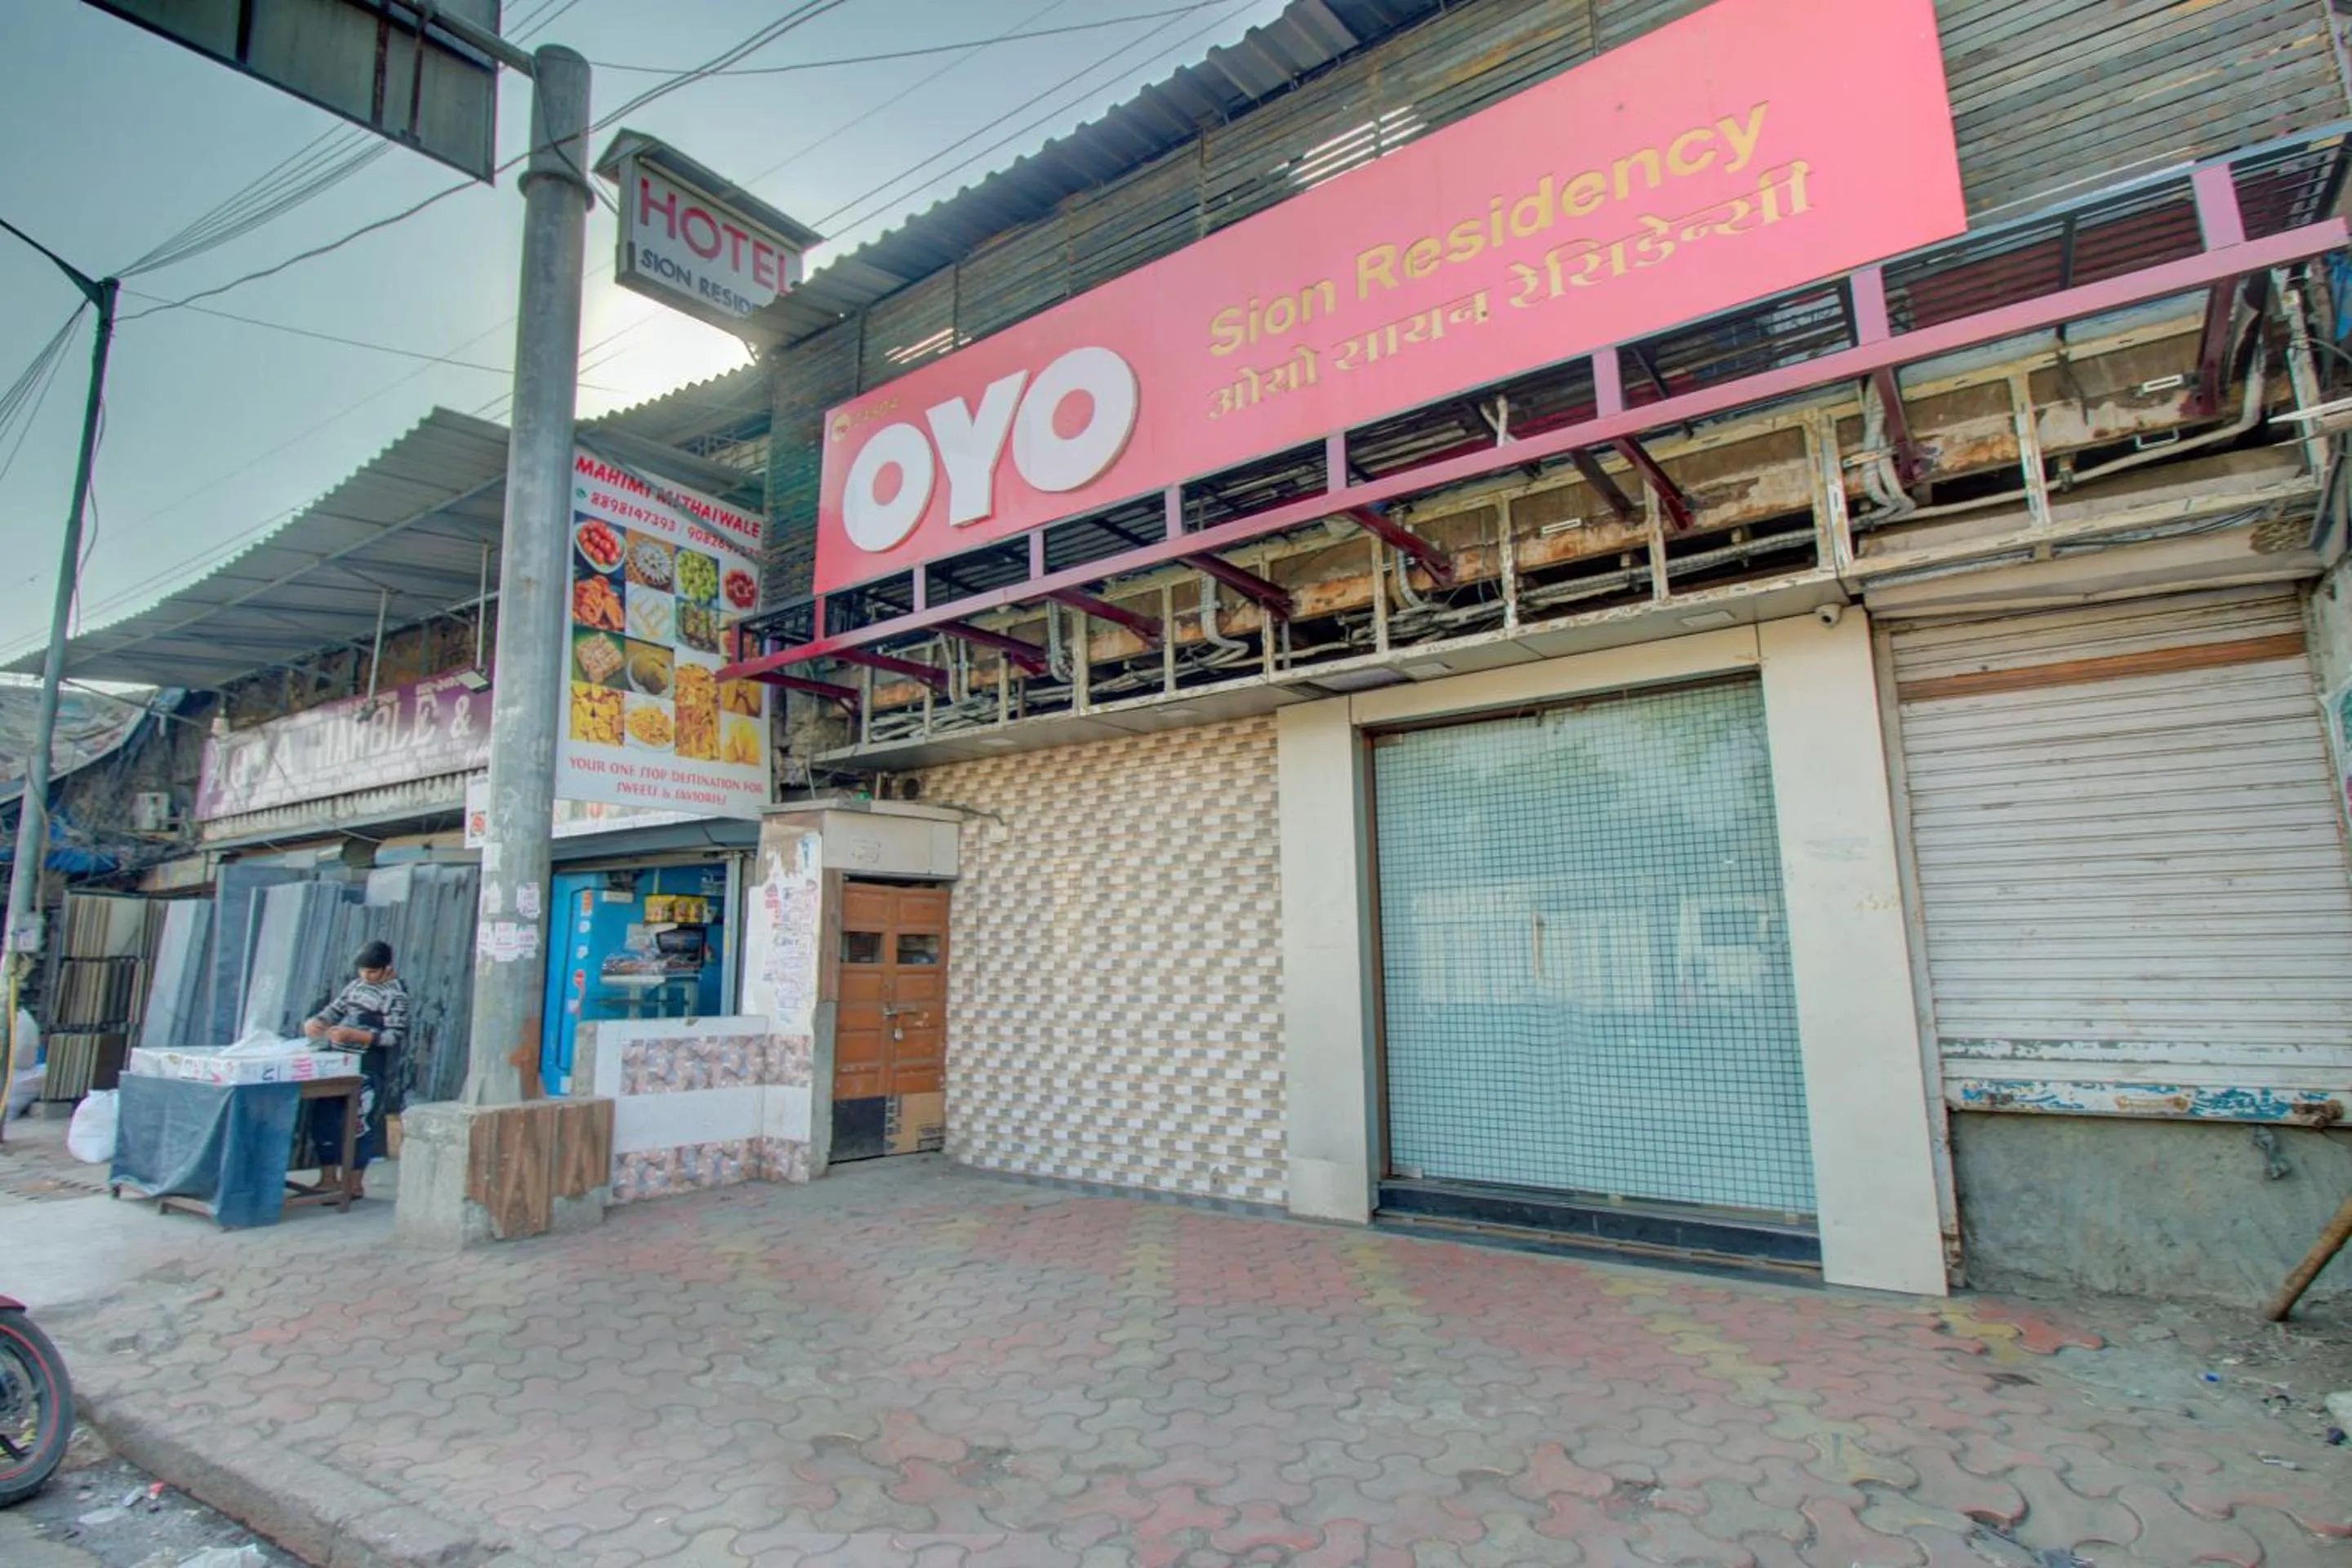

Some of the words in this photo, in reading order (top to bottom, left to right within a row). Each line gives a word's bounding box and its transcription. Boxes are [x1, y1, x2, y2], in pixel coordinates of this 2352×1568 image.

[639, 176, 791, 297] HOTEL
[640, 248, 693, 287] SION
[1207, 344, 1321, 419] ओयो
[1331, 287, 1493, 371] सायन
[1505, 158, 1815, 308] रेसिडेन्सी
[1208, 275, 1336, 358] Sion
[1356, 100, 1771, 303] Residency
[842, 346, 1140, 554] OYO
[568, 756, 606, 773] YOUR
[610, 762, 635, 777] ONE
[641, 765, 668, 780] STOP
[671, 770, 742, 791] DESTINATION
[743, 780, 764, 794] FOR
[617, 782, 657, 797] SWEETS
